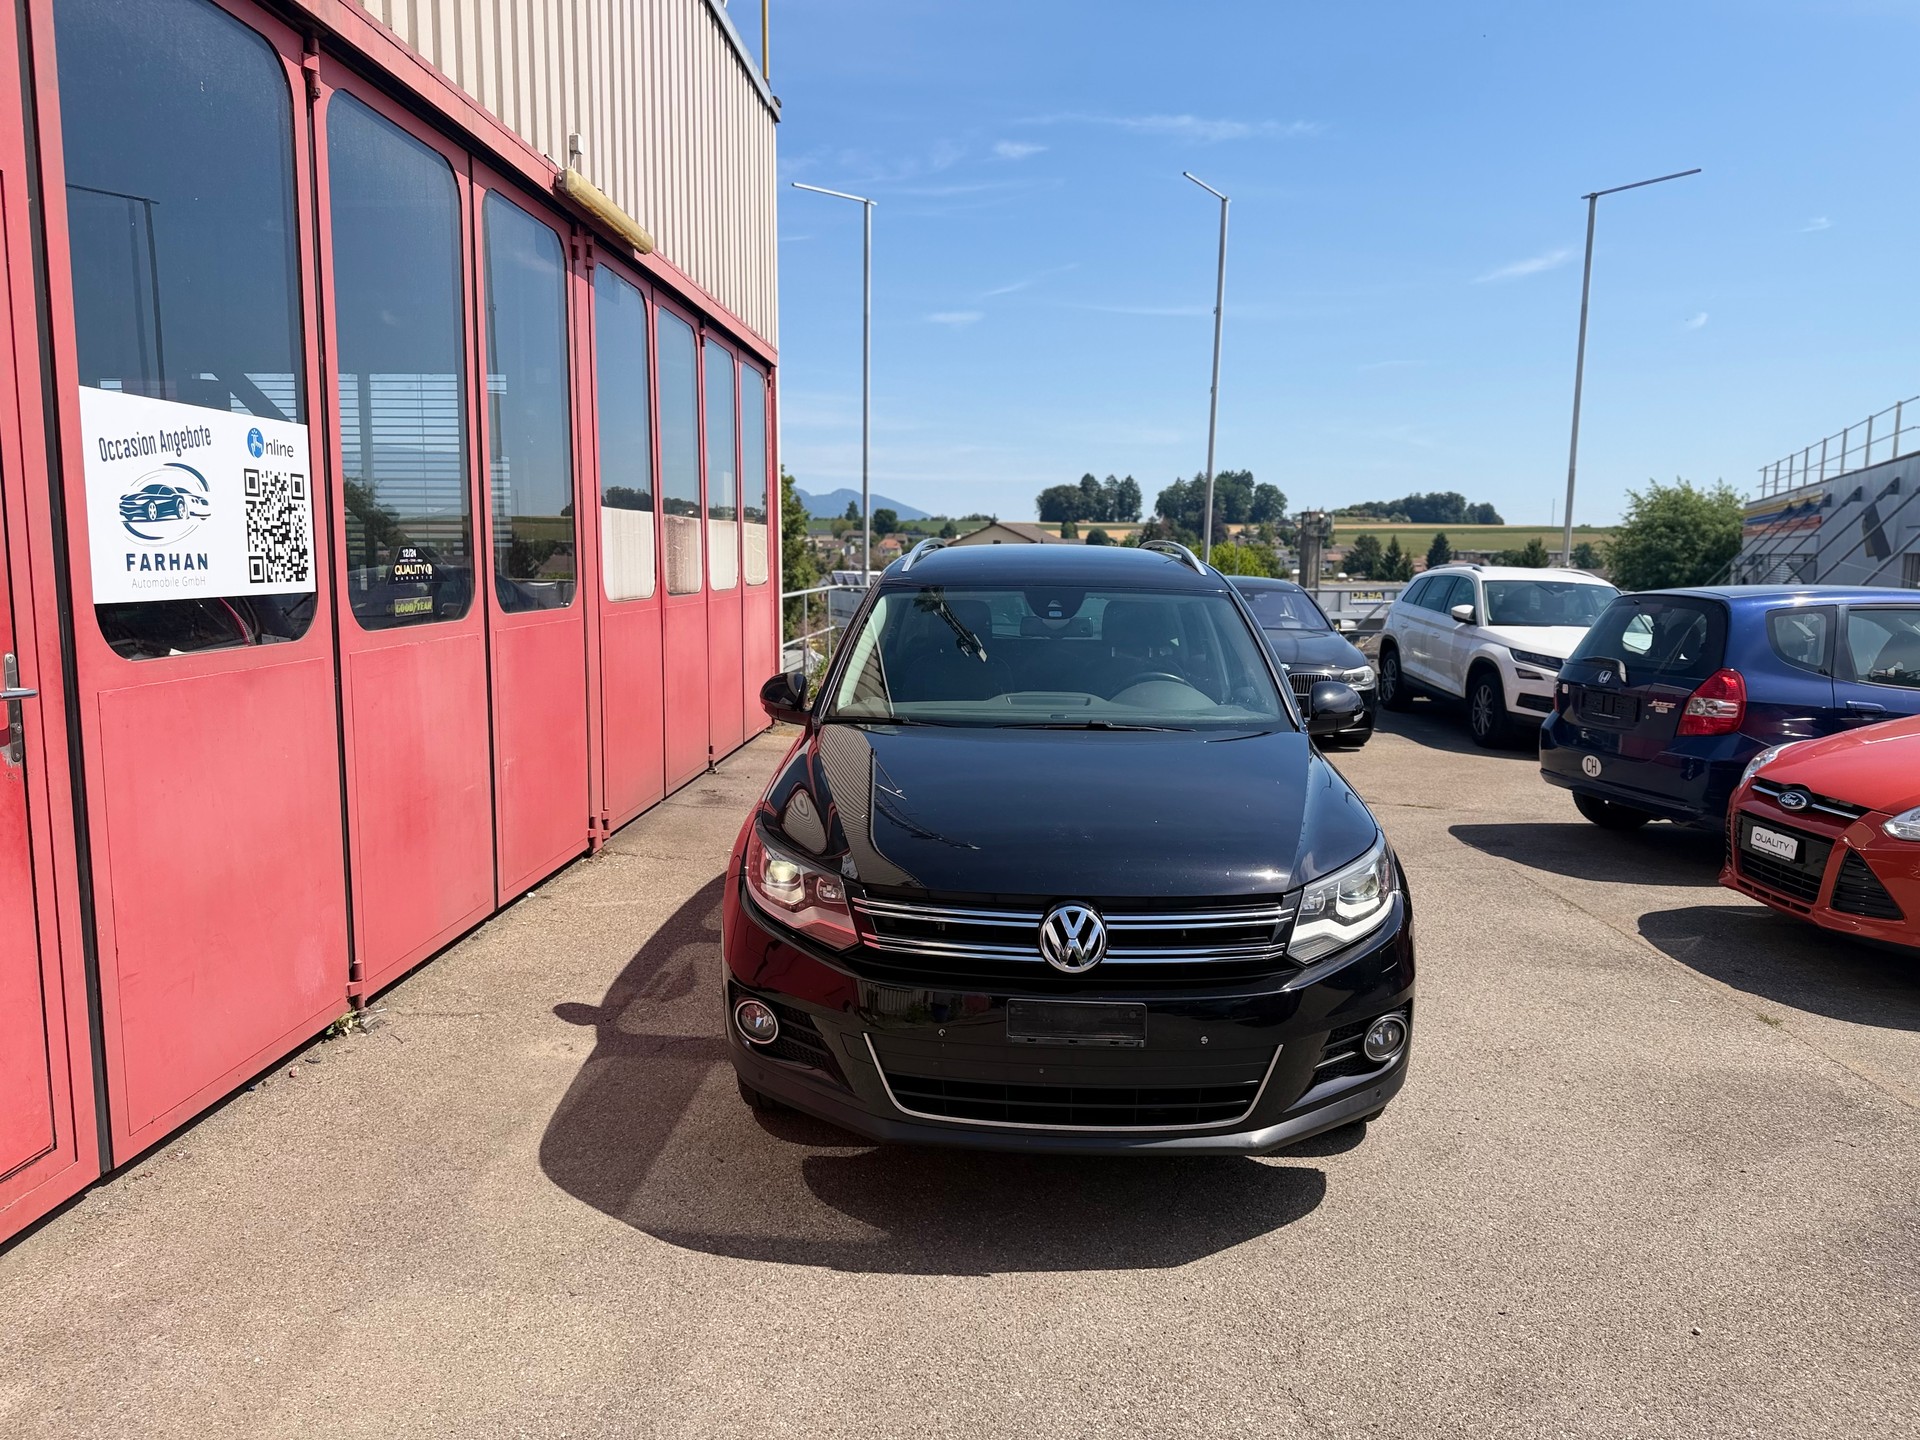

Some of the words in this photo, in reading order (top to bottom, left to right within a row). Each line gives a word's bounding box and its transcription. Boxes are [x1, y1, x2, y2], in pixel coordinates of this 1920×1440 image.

[98, 430, 157, 462] Occasion
[160, 426, 212, 458] Angebote
[126, 553, 209, 572] FARHAN
[132, 577, 180, 590] Automobile
[182, 576, 206, 588] GmbH
[1586, 757, 1597, 775] CH
[1781, 793, 1799, 806] Ford
[1755, 833, 1790, 851] QUALITY
